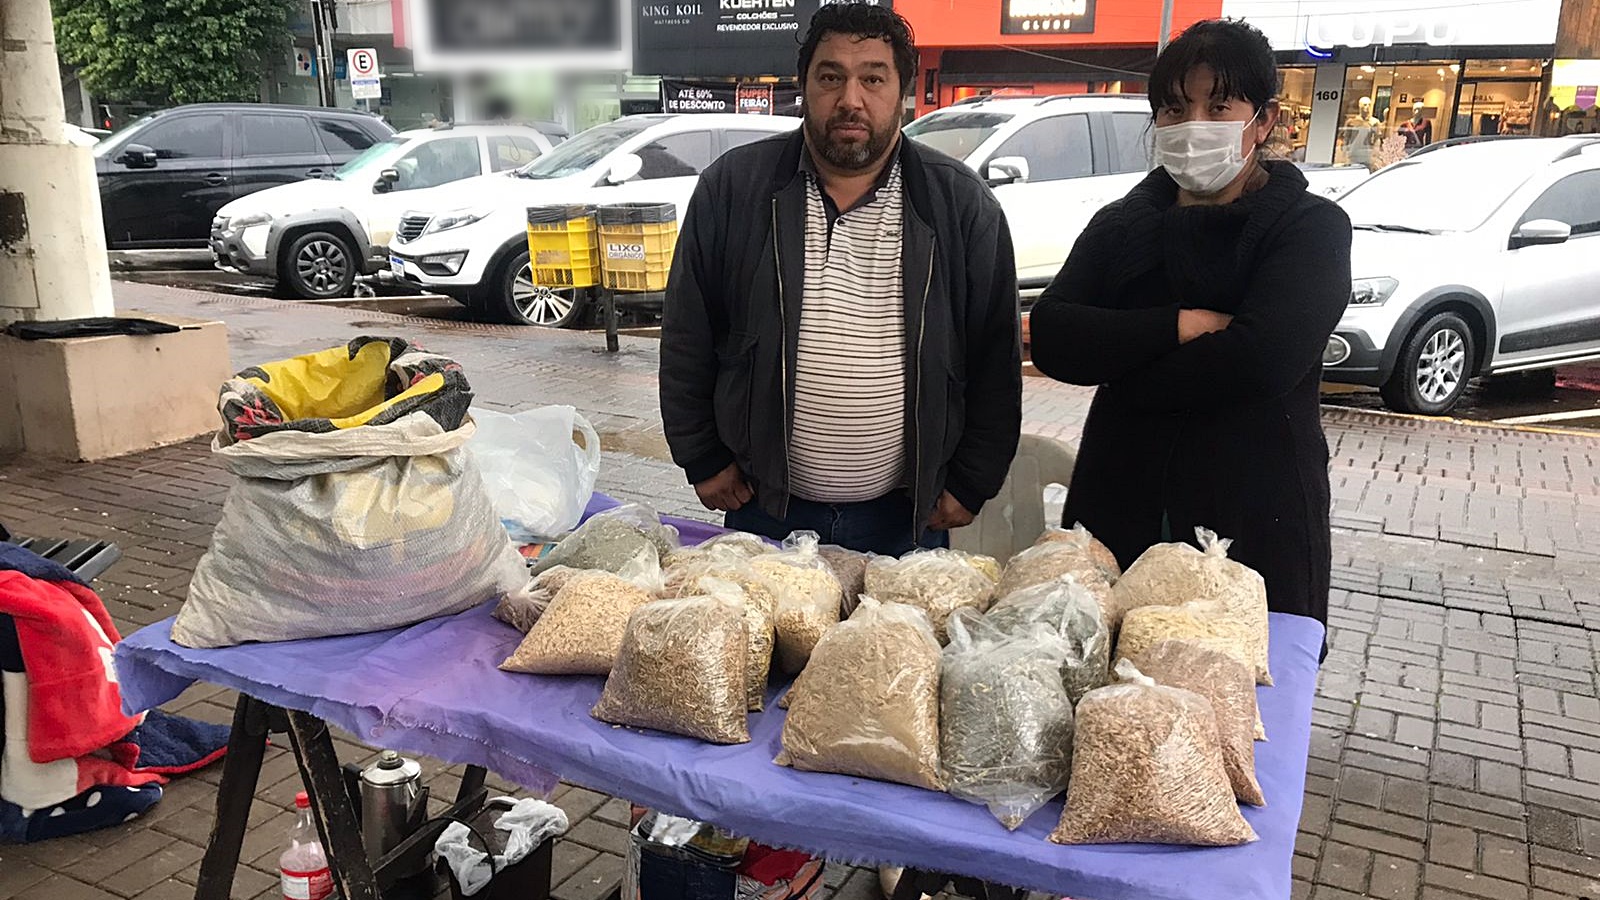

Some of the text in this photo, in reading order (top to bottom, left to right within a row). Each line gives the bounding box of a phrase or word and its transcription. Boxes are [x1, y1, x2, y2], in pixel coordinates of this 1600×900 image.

[719, 0, 795, 9] KUERTEN
[642, 4, 703, 16] KING KOIL
[736, 12, 778, 20] COLCHÕES
[716, 23, 799, 31] REVENDEDOR EXCLUSIVO
[359, 54, 368, 69] E
[678, 88, 713, 99] ATÉ 60%
[740, 88, 769, 98] SUPER
[1315, 90, 1338, 101] 160
[668, 100, 726, 110] DE DESCONTO
[740, 97, 769, 108] FEIRÃO
[610, 244, 641, 252] LIXO
